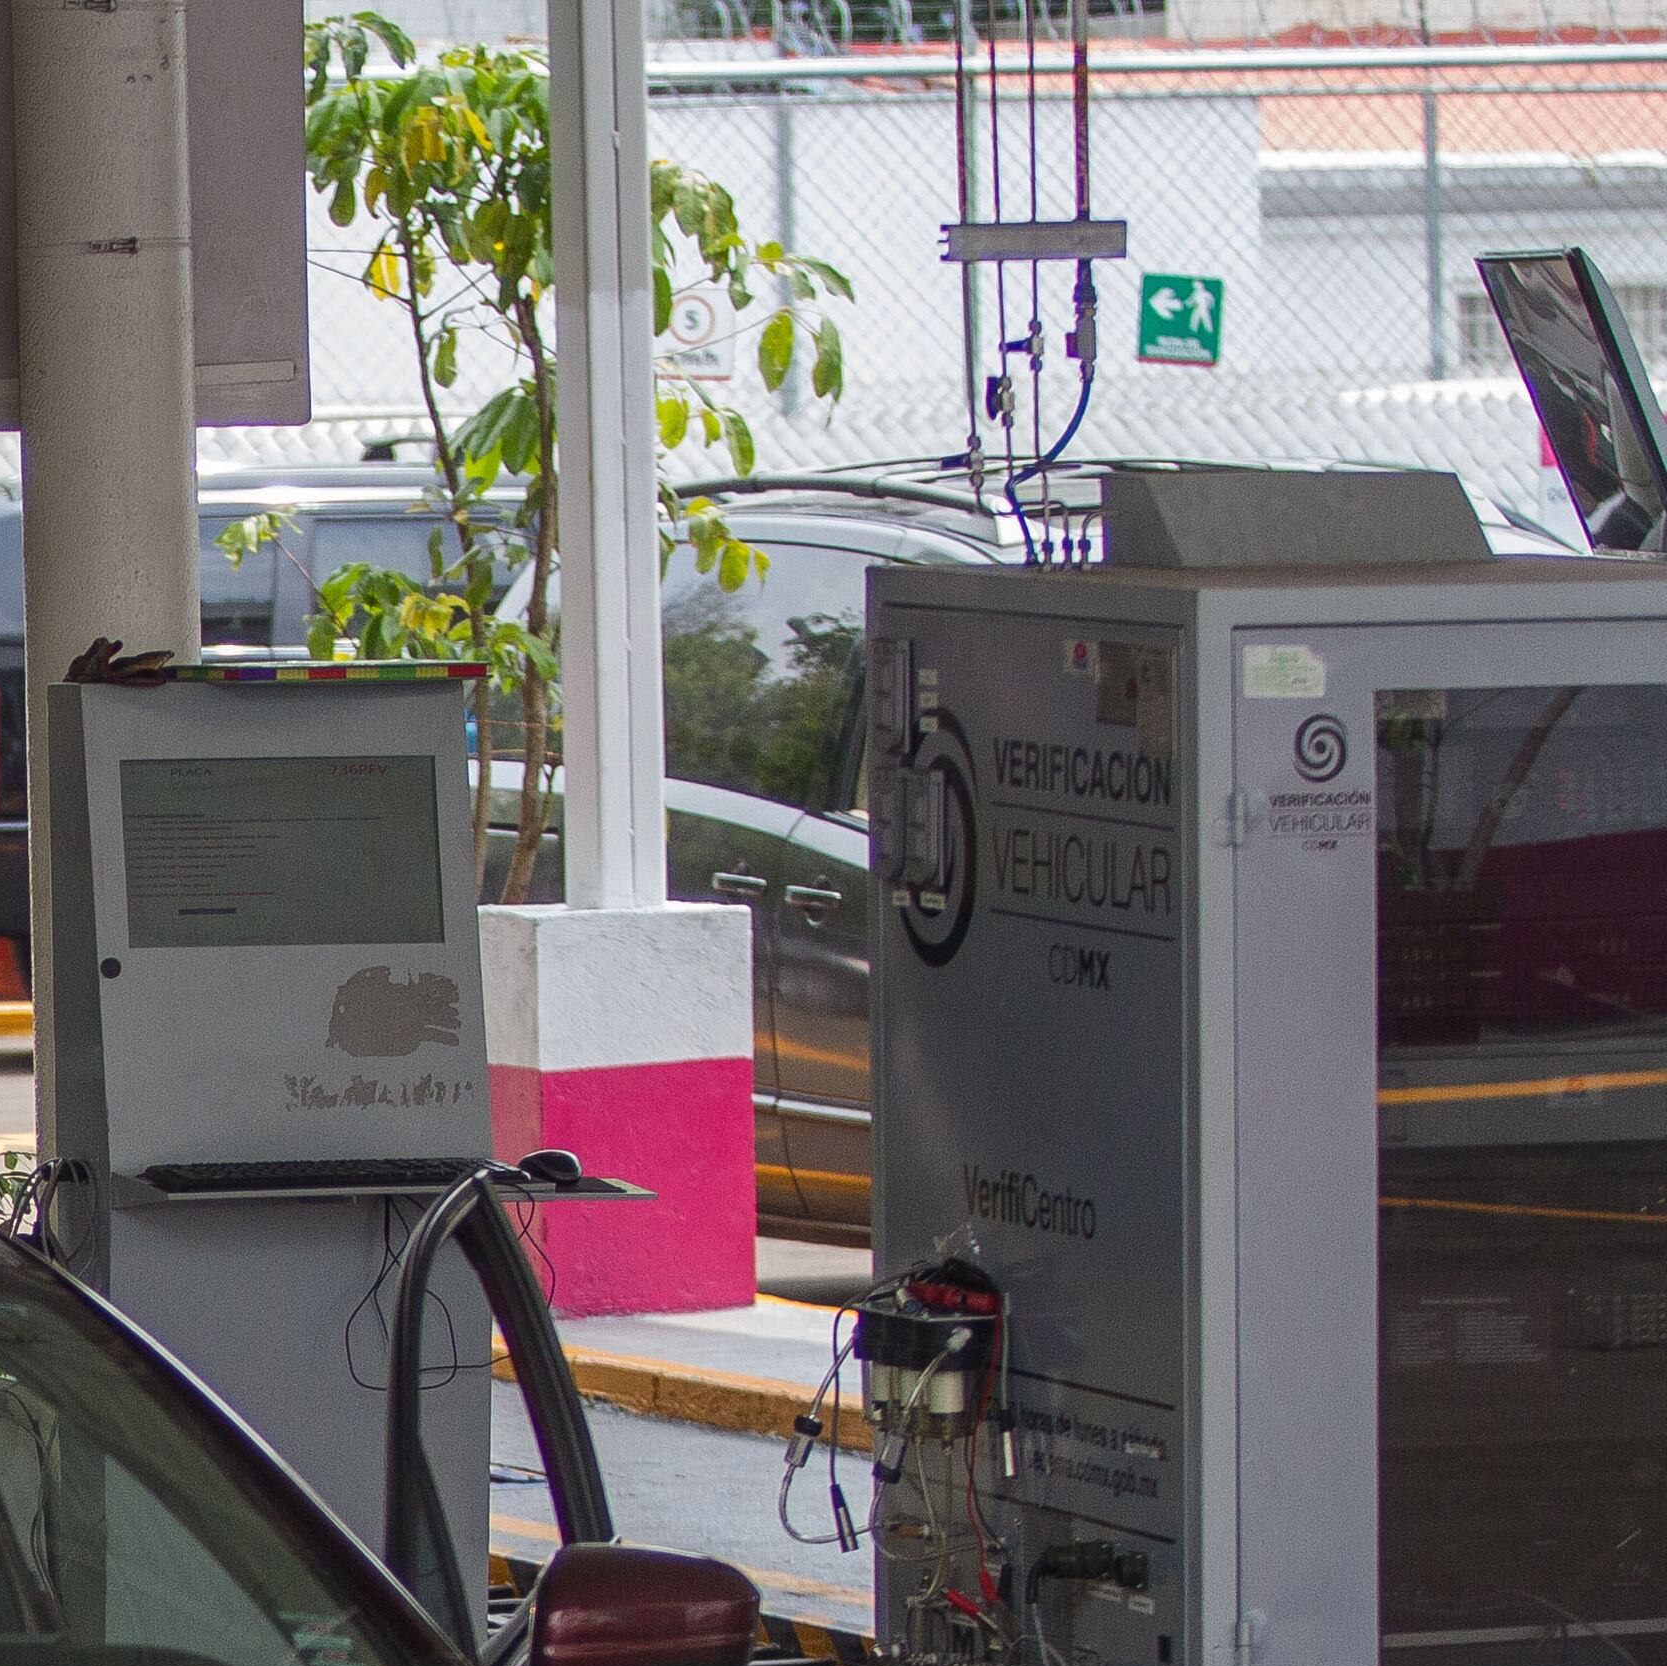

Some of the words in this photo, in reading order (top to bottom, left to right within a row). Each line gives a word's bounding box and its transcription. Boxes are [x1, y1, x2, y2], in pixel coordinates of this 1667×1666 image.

[1268, 812, 1372, 833] VEHICULAR
[992, 826, 1172, 915] VEHICULAR
[1048, 942, 1111, 992] CDMX
[964, 1164, 1097, 1240] VerifiCentro
